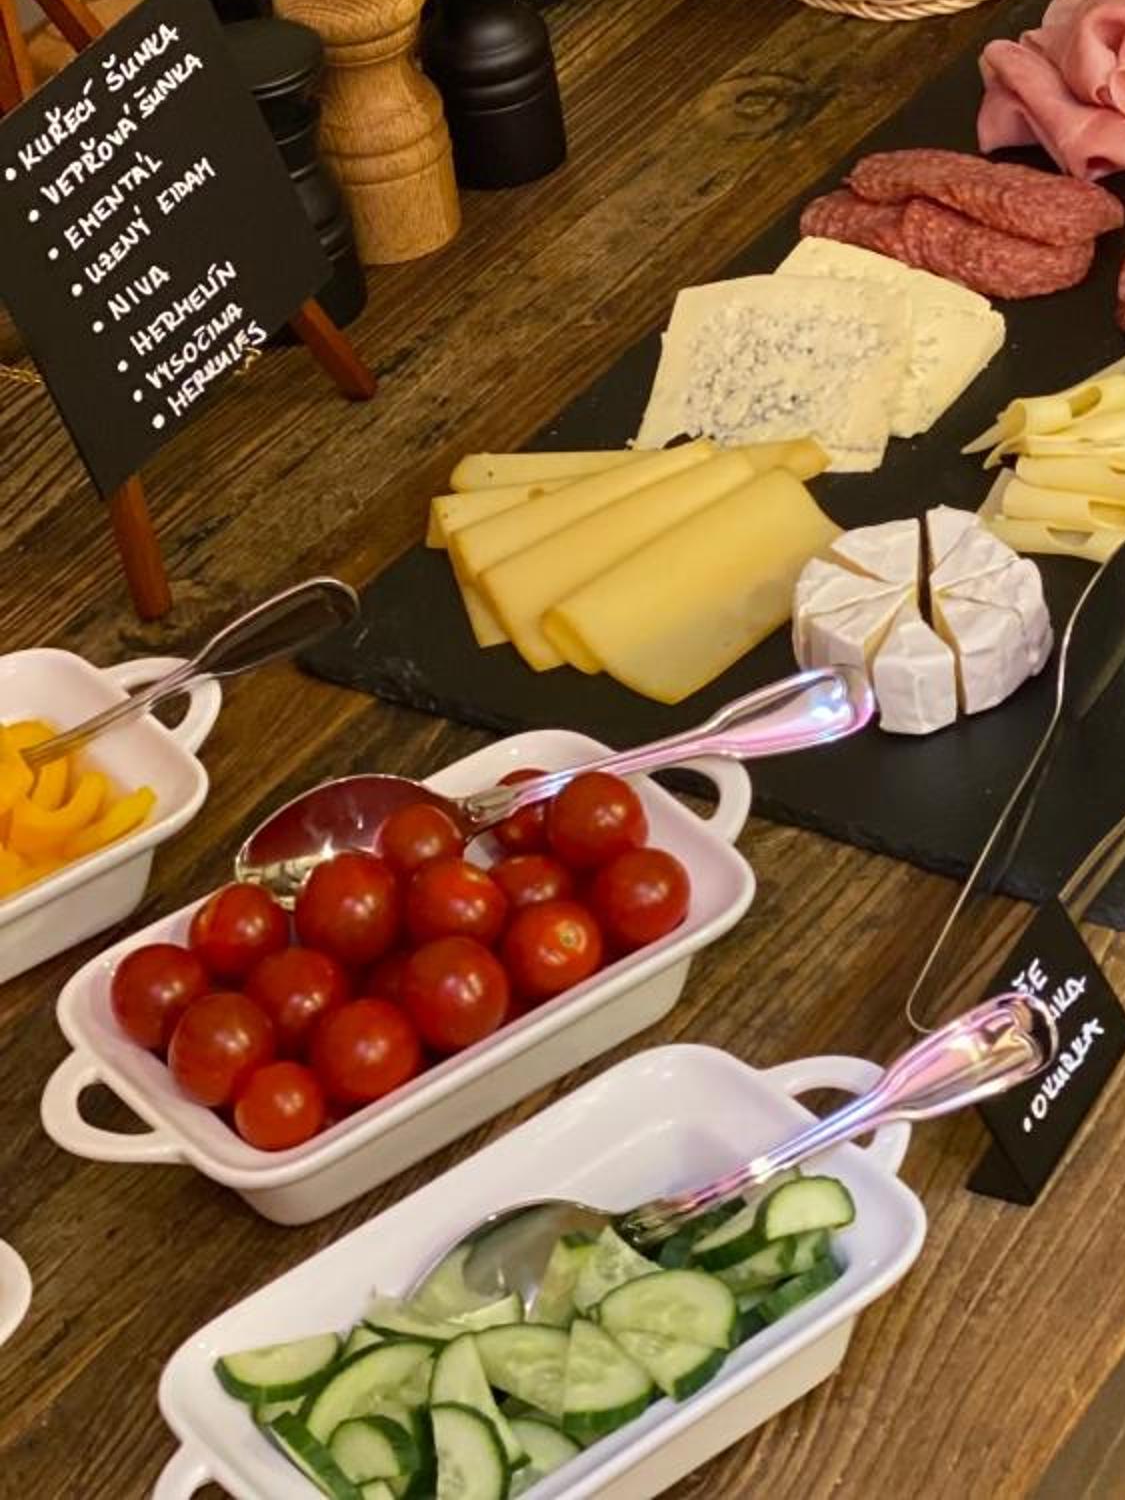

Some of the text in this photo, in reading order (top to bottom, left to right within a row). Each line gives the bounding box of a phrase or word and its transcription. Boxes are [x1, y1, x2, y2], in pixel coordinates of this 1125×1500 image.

[18, 23, 179, 171] KUŘECÍ ŠUNKA
[40, 53, 203, 205] VEPŘOVÁ ŠUNKA
[63, 151, 163, 250] EMENTÁL
[156, 157, 215, 215] EIDAM
[107, 265, 170, 321] NIVA
[129, 260, 237, 356] HERMELÍN
[145, 303, 243, 388] VYSOČINA
[167, 320, 267, 417] HERKULES
[1032, 1018, 1105, 1120] OKURKA
